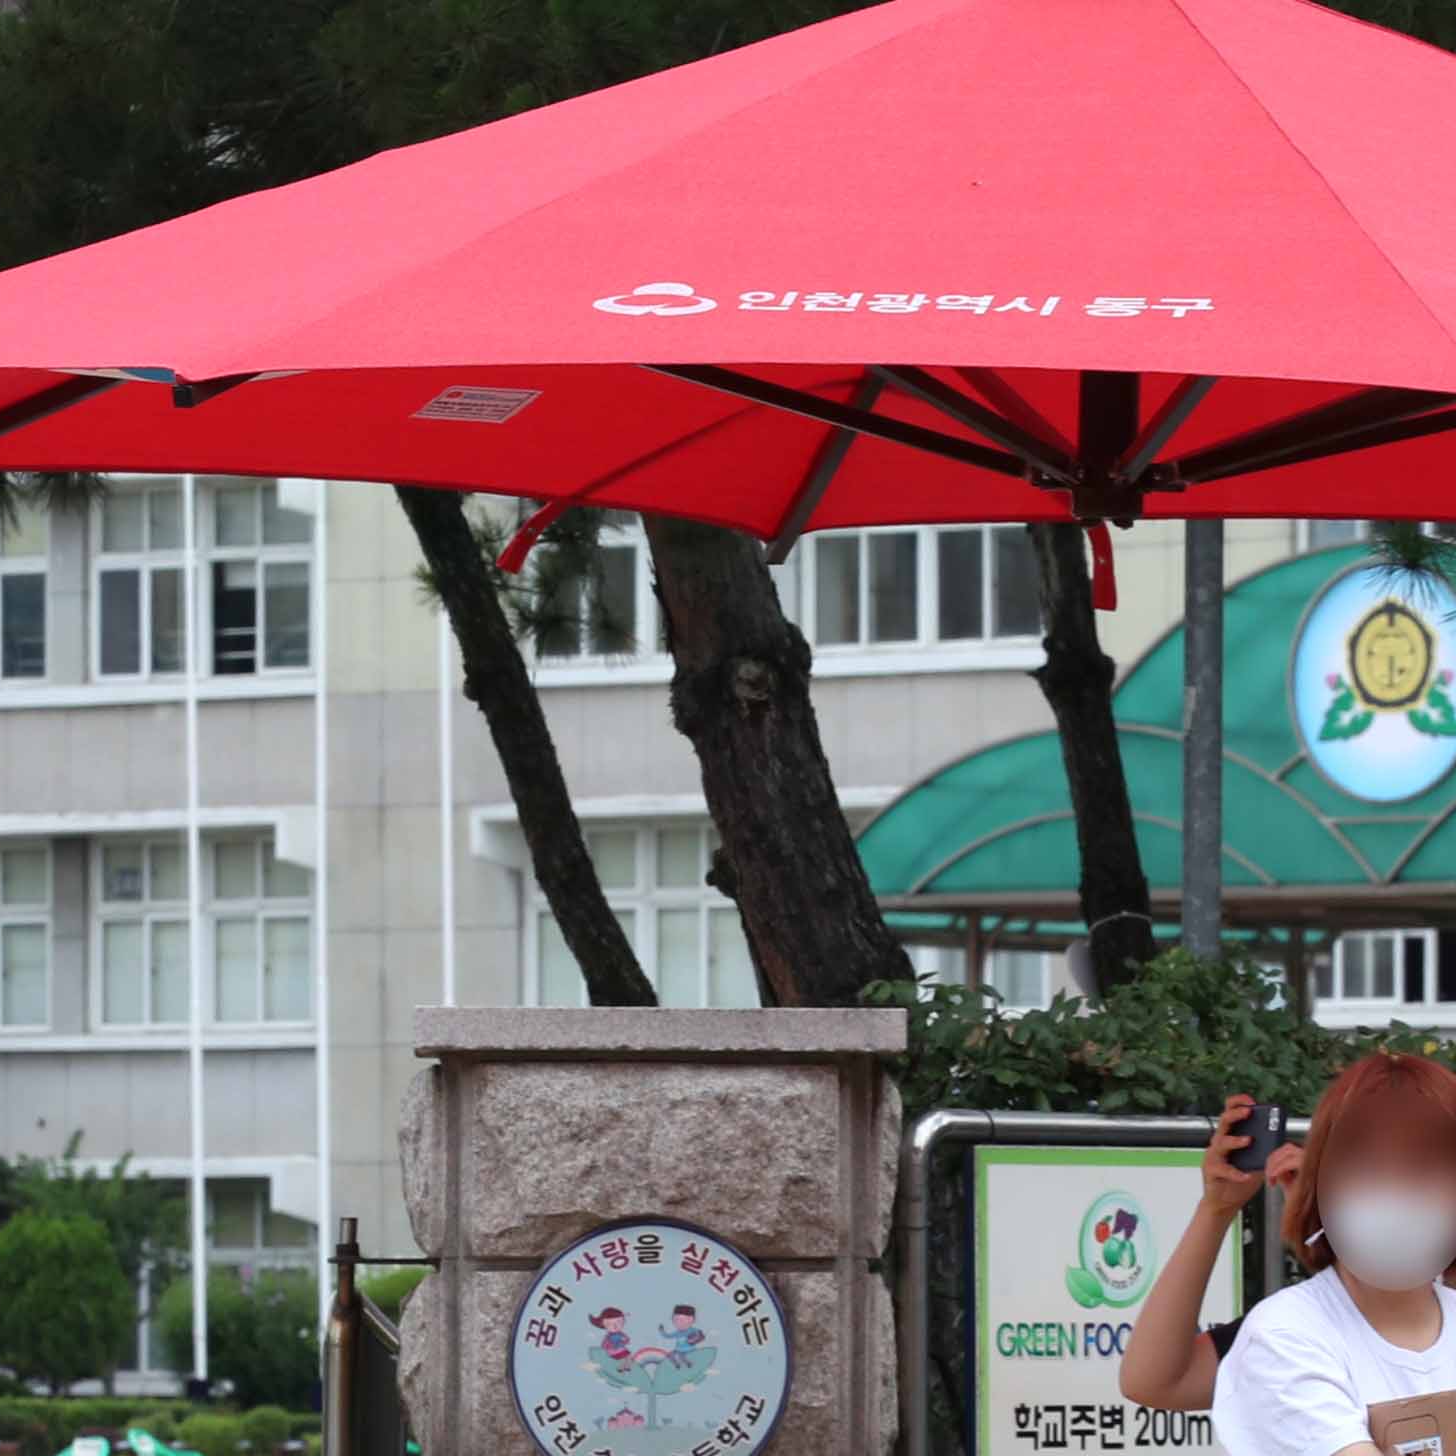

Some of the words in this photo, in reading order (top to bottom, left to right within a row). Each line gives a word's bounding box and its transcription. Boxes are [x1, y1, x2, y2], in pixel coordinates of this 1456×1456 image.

[738, 291, 1061, 317] 인천광역시
[1083, 296, 1216, 318] 동구
[525, 1285, 573, 1348] 꿈과
[571, 1233, 664, 1283] 사랑을
[679, 1241, 771, 1346] 실천하는
[996, 1322, 1076, 1357] GREEN
[1084, 1322, 1133, 1357] FOO
[534, 1394, 586, 1455] 인천
[1014, 1403, 1124, 1450] 학교주변
[1134, 1406, 1213, 1447] 200m
